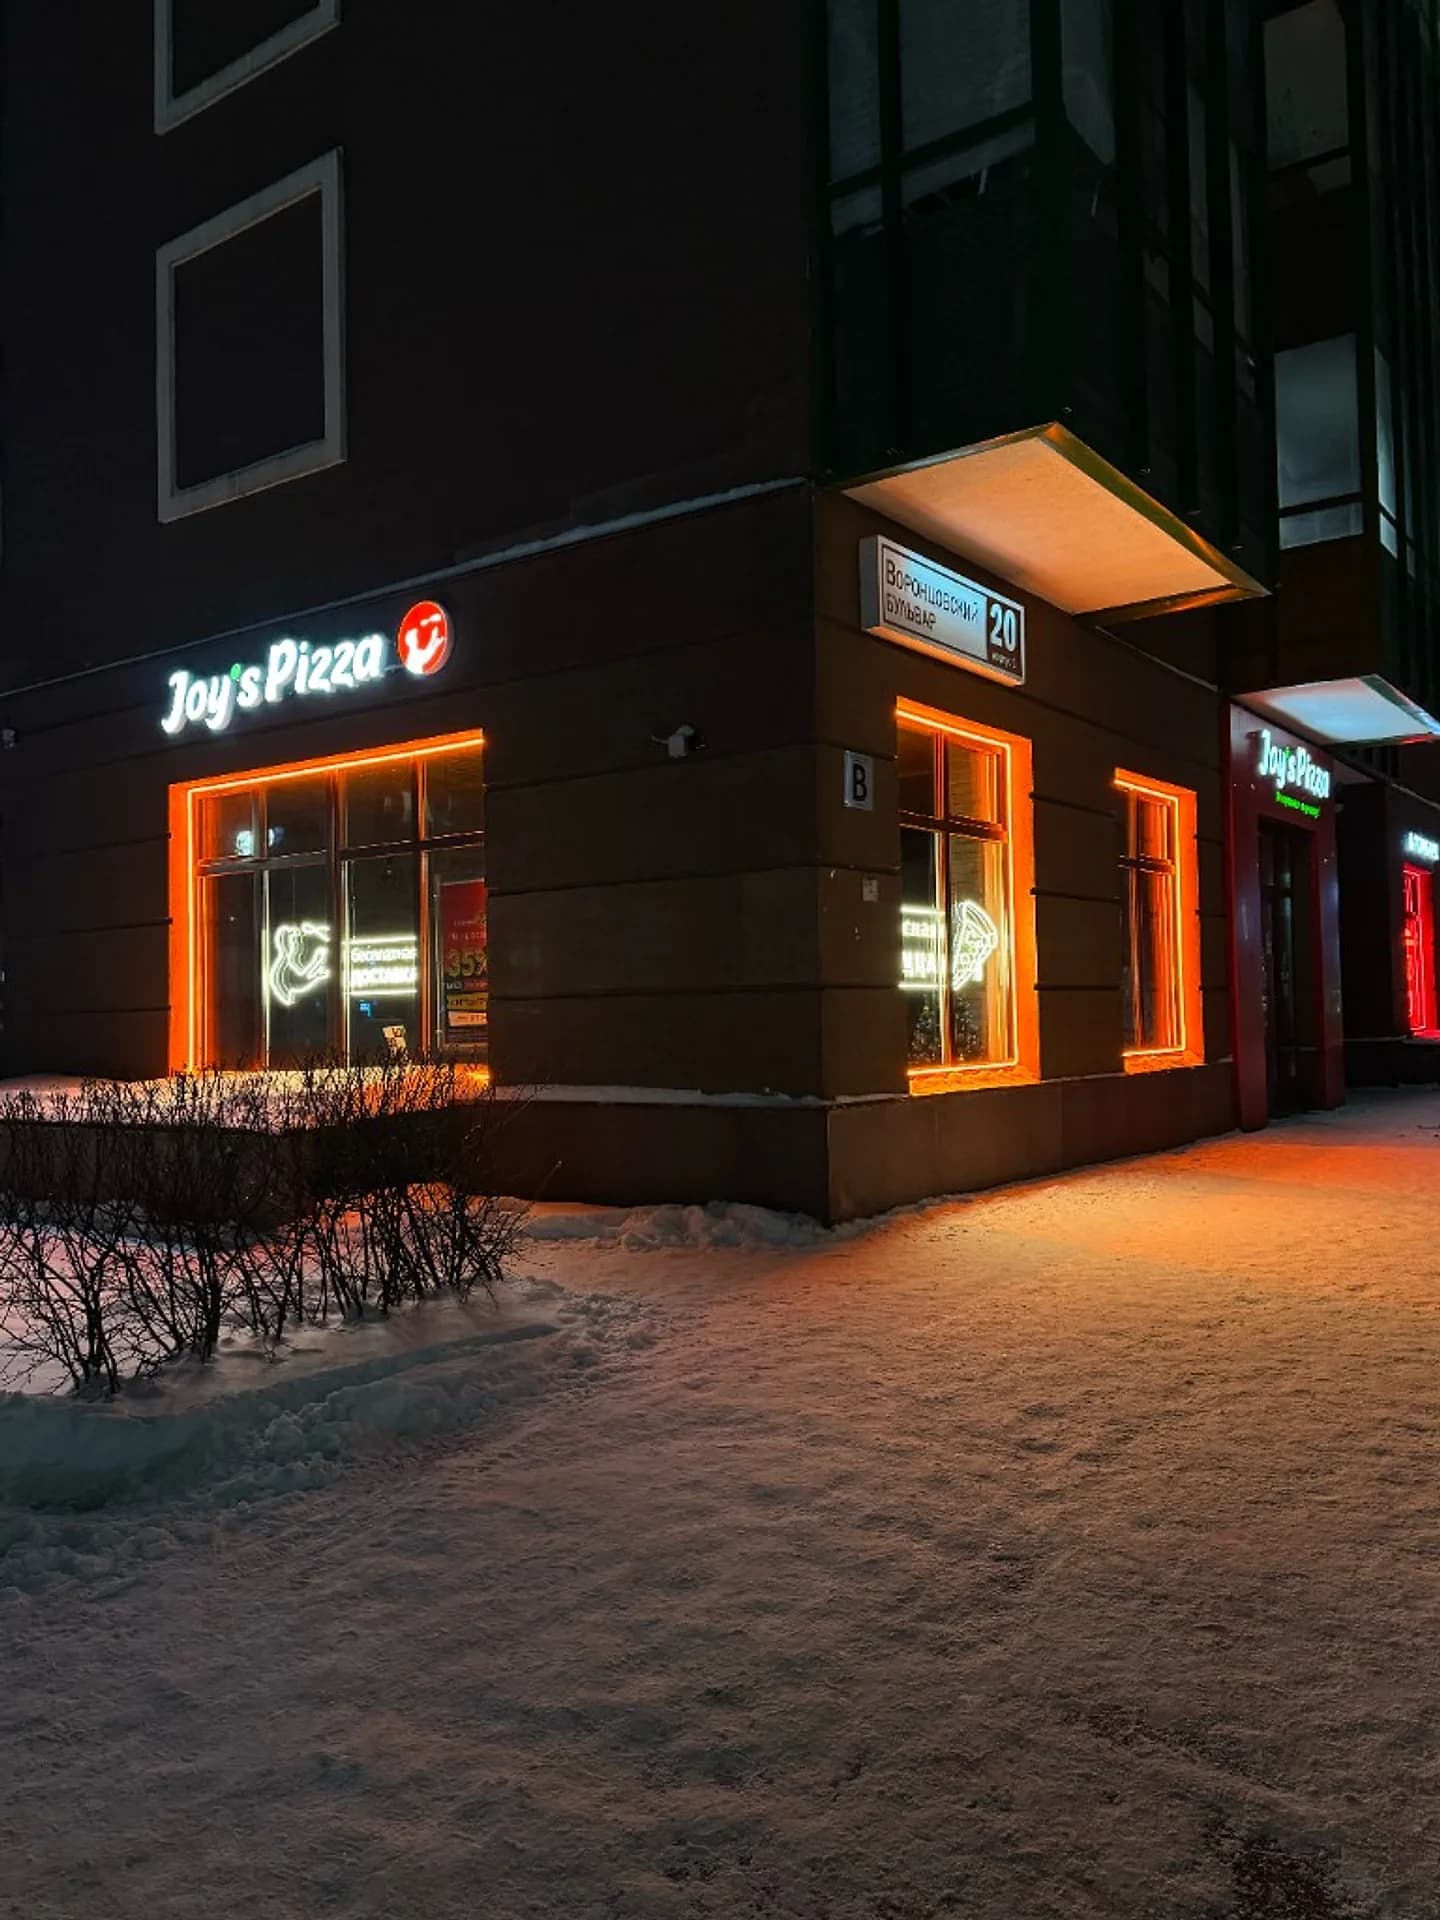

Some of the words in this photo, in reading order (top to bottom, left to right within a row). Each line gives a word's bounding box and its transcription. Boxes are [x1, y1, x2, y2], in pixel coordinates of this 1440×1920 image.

[990, 603, 1016, 652] 20
[160, 663, 262, 734] Joy's
[264, 633, 385, 703] Pizza
[1295, 746, 1331, 799] Pizza
